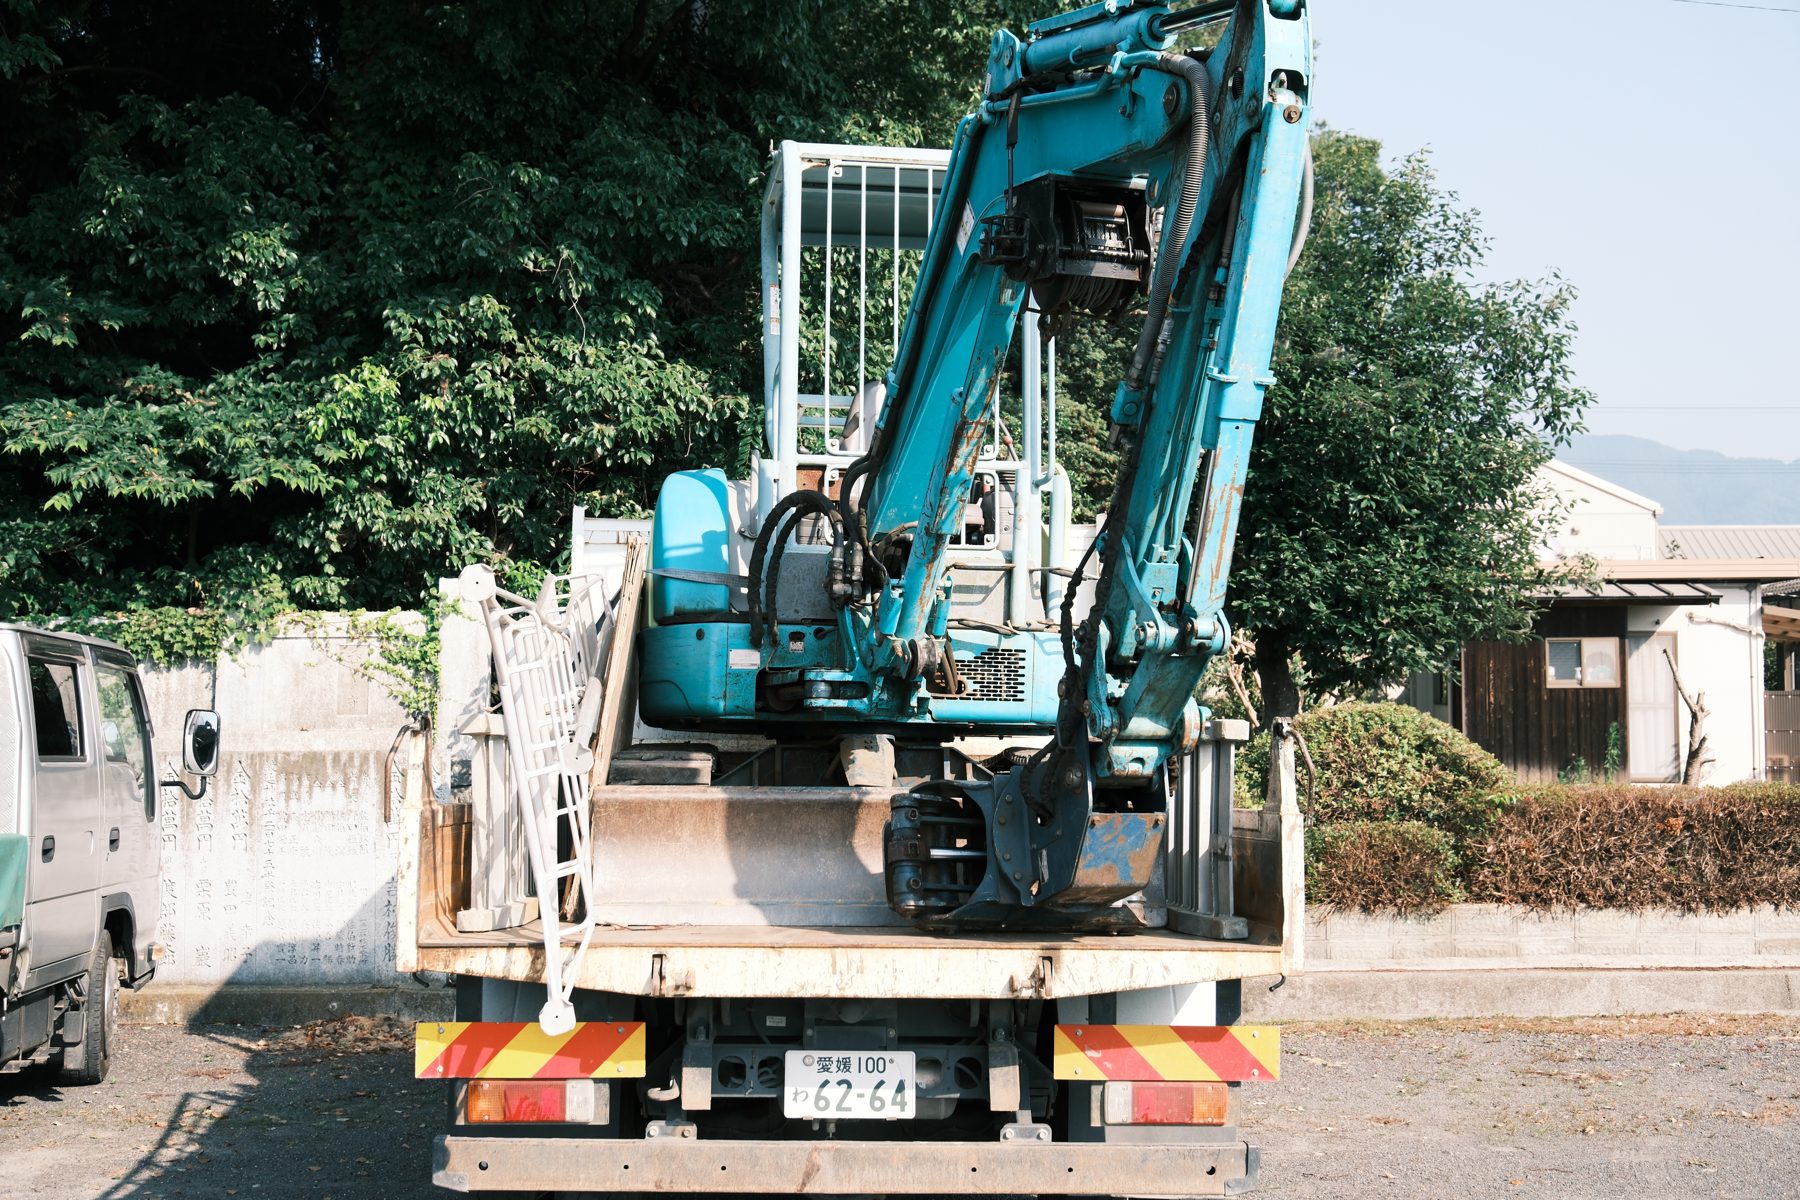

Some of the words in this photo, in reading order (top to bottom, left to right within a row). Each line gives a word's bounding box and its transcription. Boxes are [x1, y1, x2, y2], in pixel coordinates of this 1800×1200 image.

[816, 1056, 852, 1074] 愛媛
[857, 1056, 887, 1074] 100
[791, 1087, 809, 1103] わ
[813, 1078, 908, 1112] 62-64
